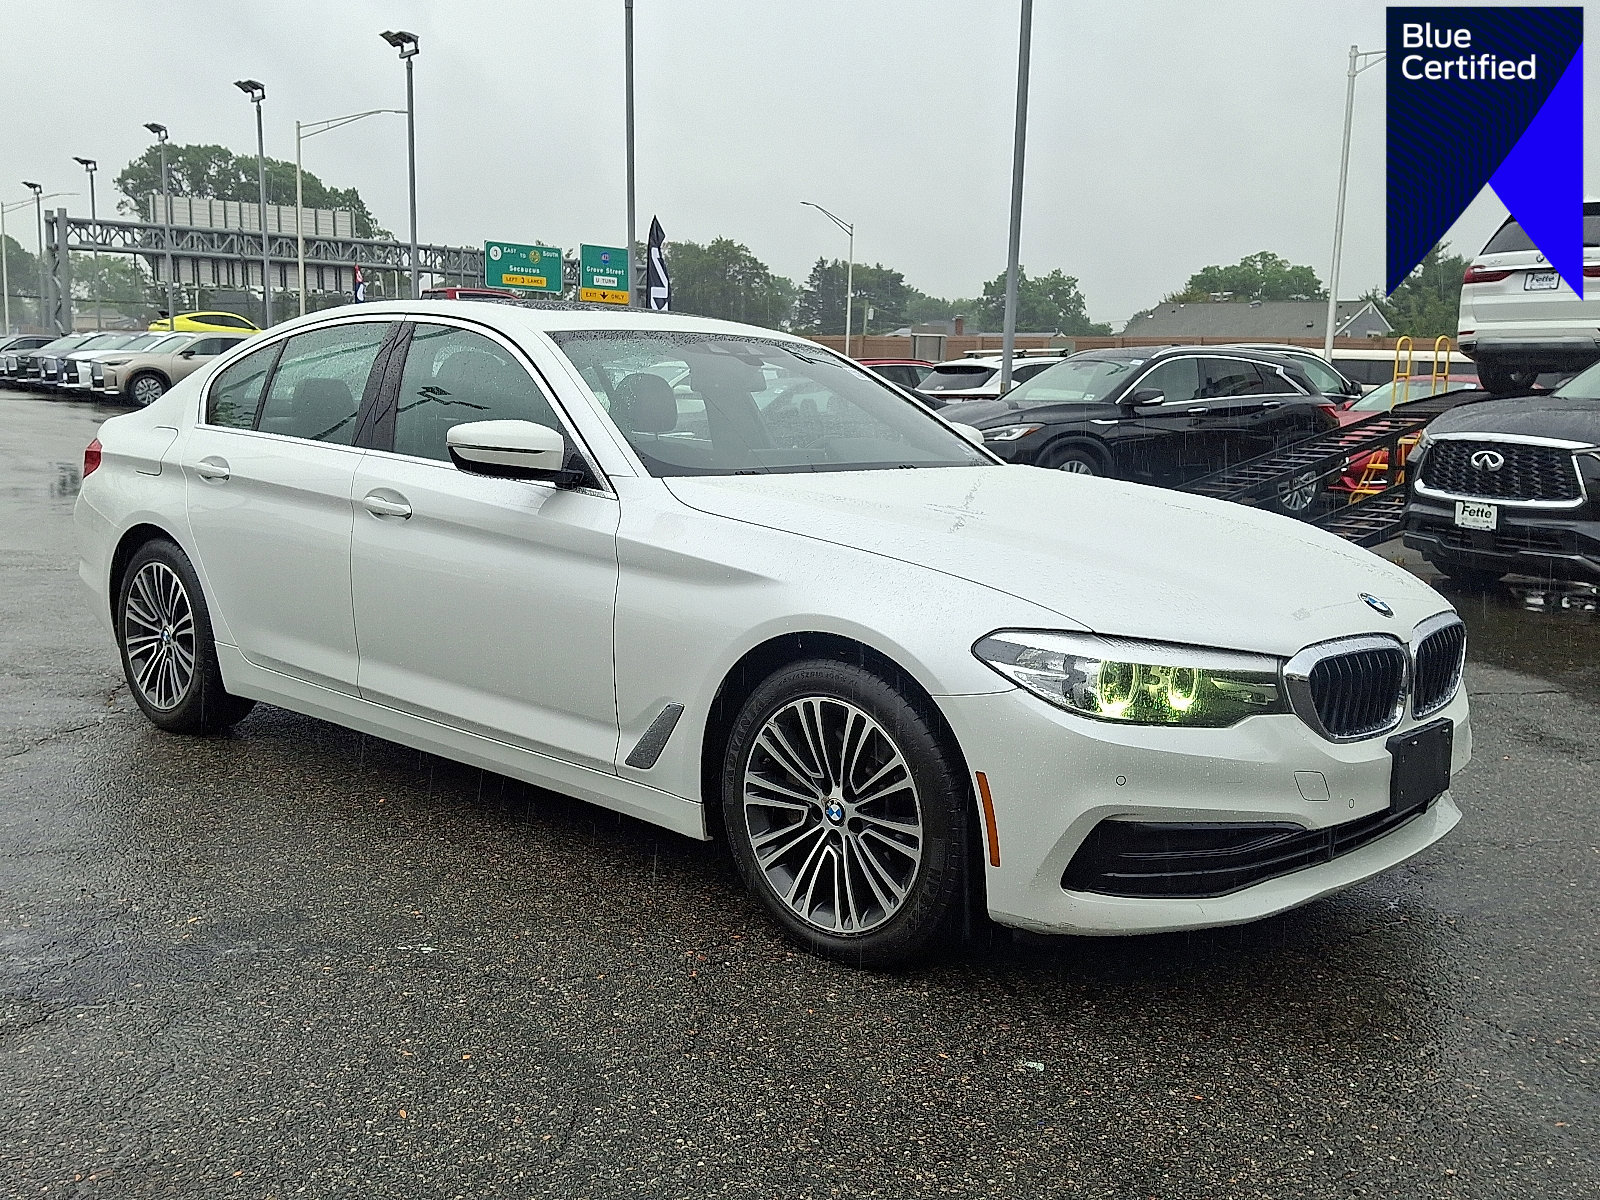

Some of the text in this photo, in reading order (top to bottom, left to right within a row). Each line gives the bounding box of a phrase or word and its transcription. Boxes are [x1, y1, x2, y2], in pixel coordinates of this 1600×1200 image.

[493, 249, 498, 257] 3
[586, 265, 625, 275] Grove Street
[1461, 504, 1492, 519] Fette
